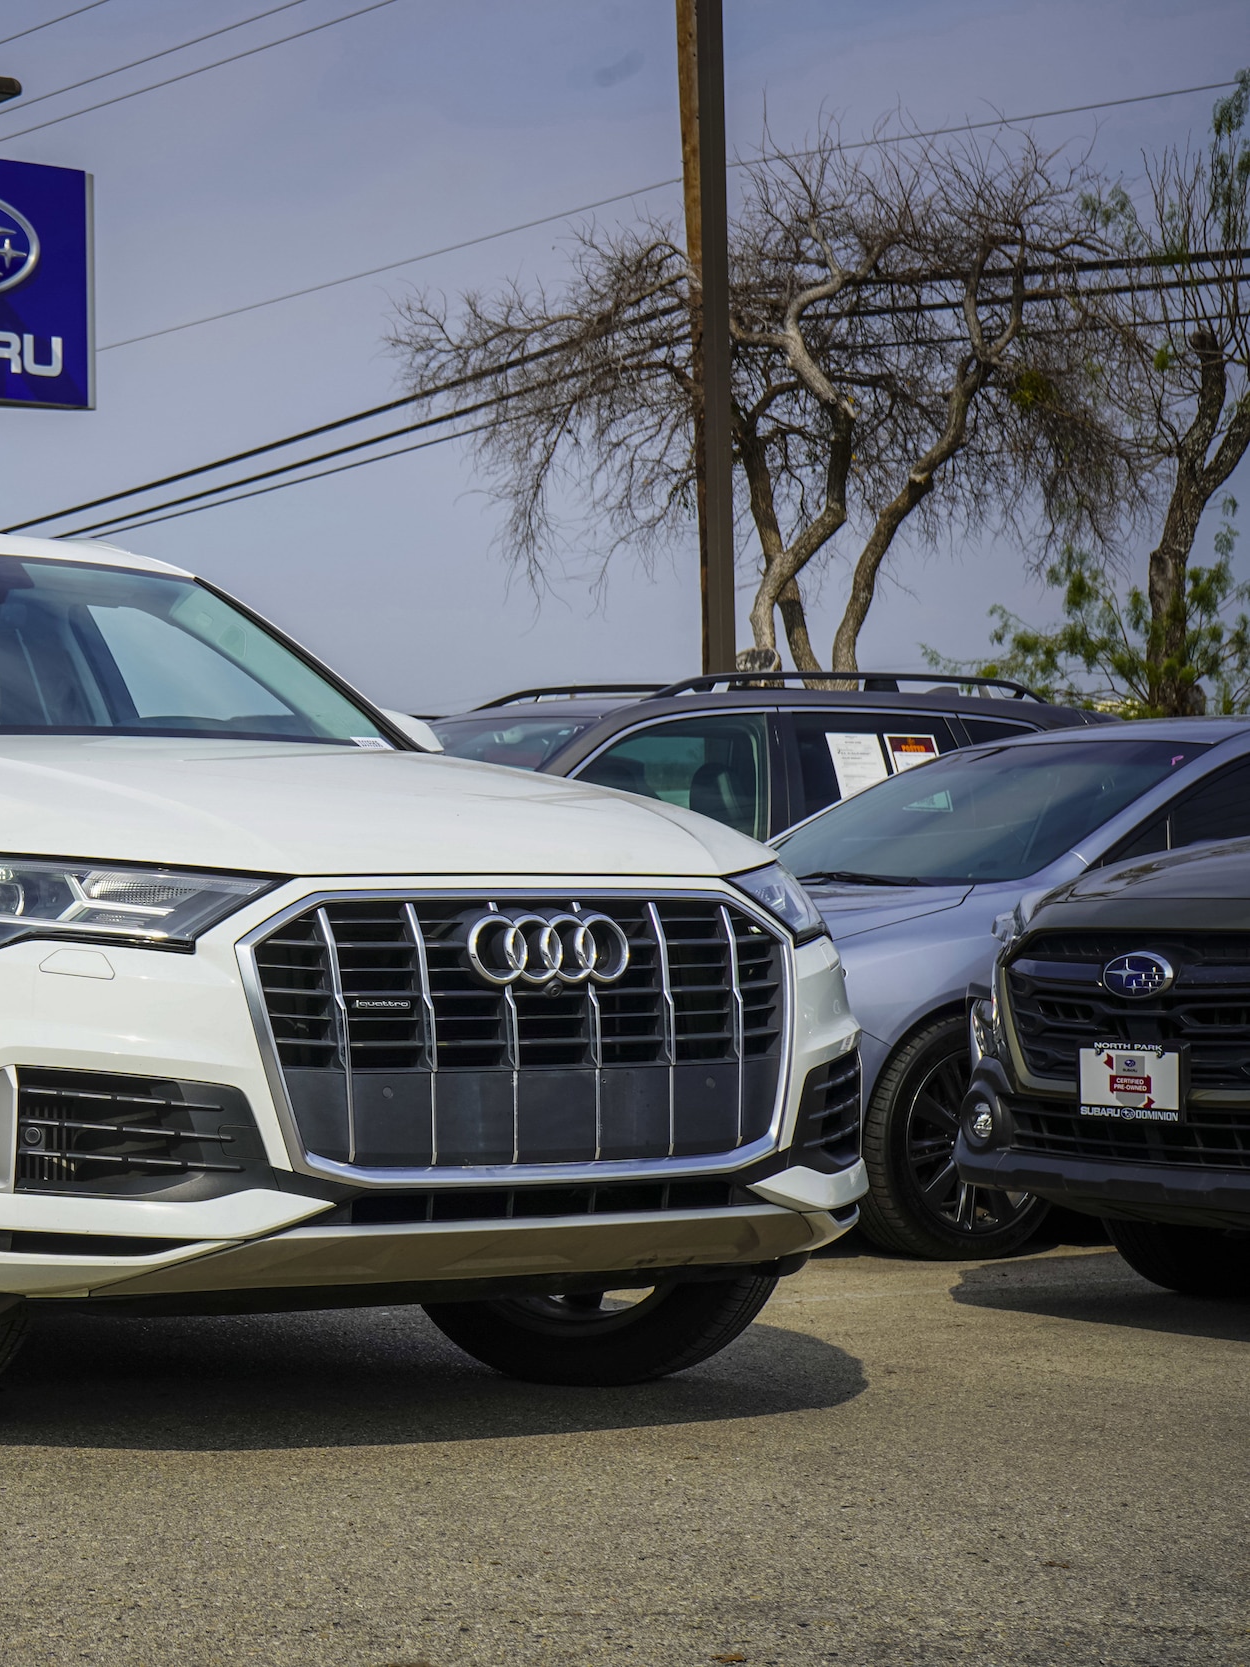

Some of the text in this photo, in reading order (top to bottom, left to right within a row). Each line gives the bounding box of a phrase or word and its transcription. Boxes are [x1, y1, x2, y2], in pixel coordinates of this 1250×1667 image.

[1094, 1042, 1130, 1050] NORTH
[1116, 1077, 1144, 1085] CERTIFIED
[1113, 1084, 1147, 1092] PRE-OWNED
[1080, 1106, 1178, 1121] SUBARU DOMINION
